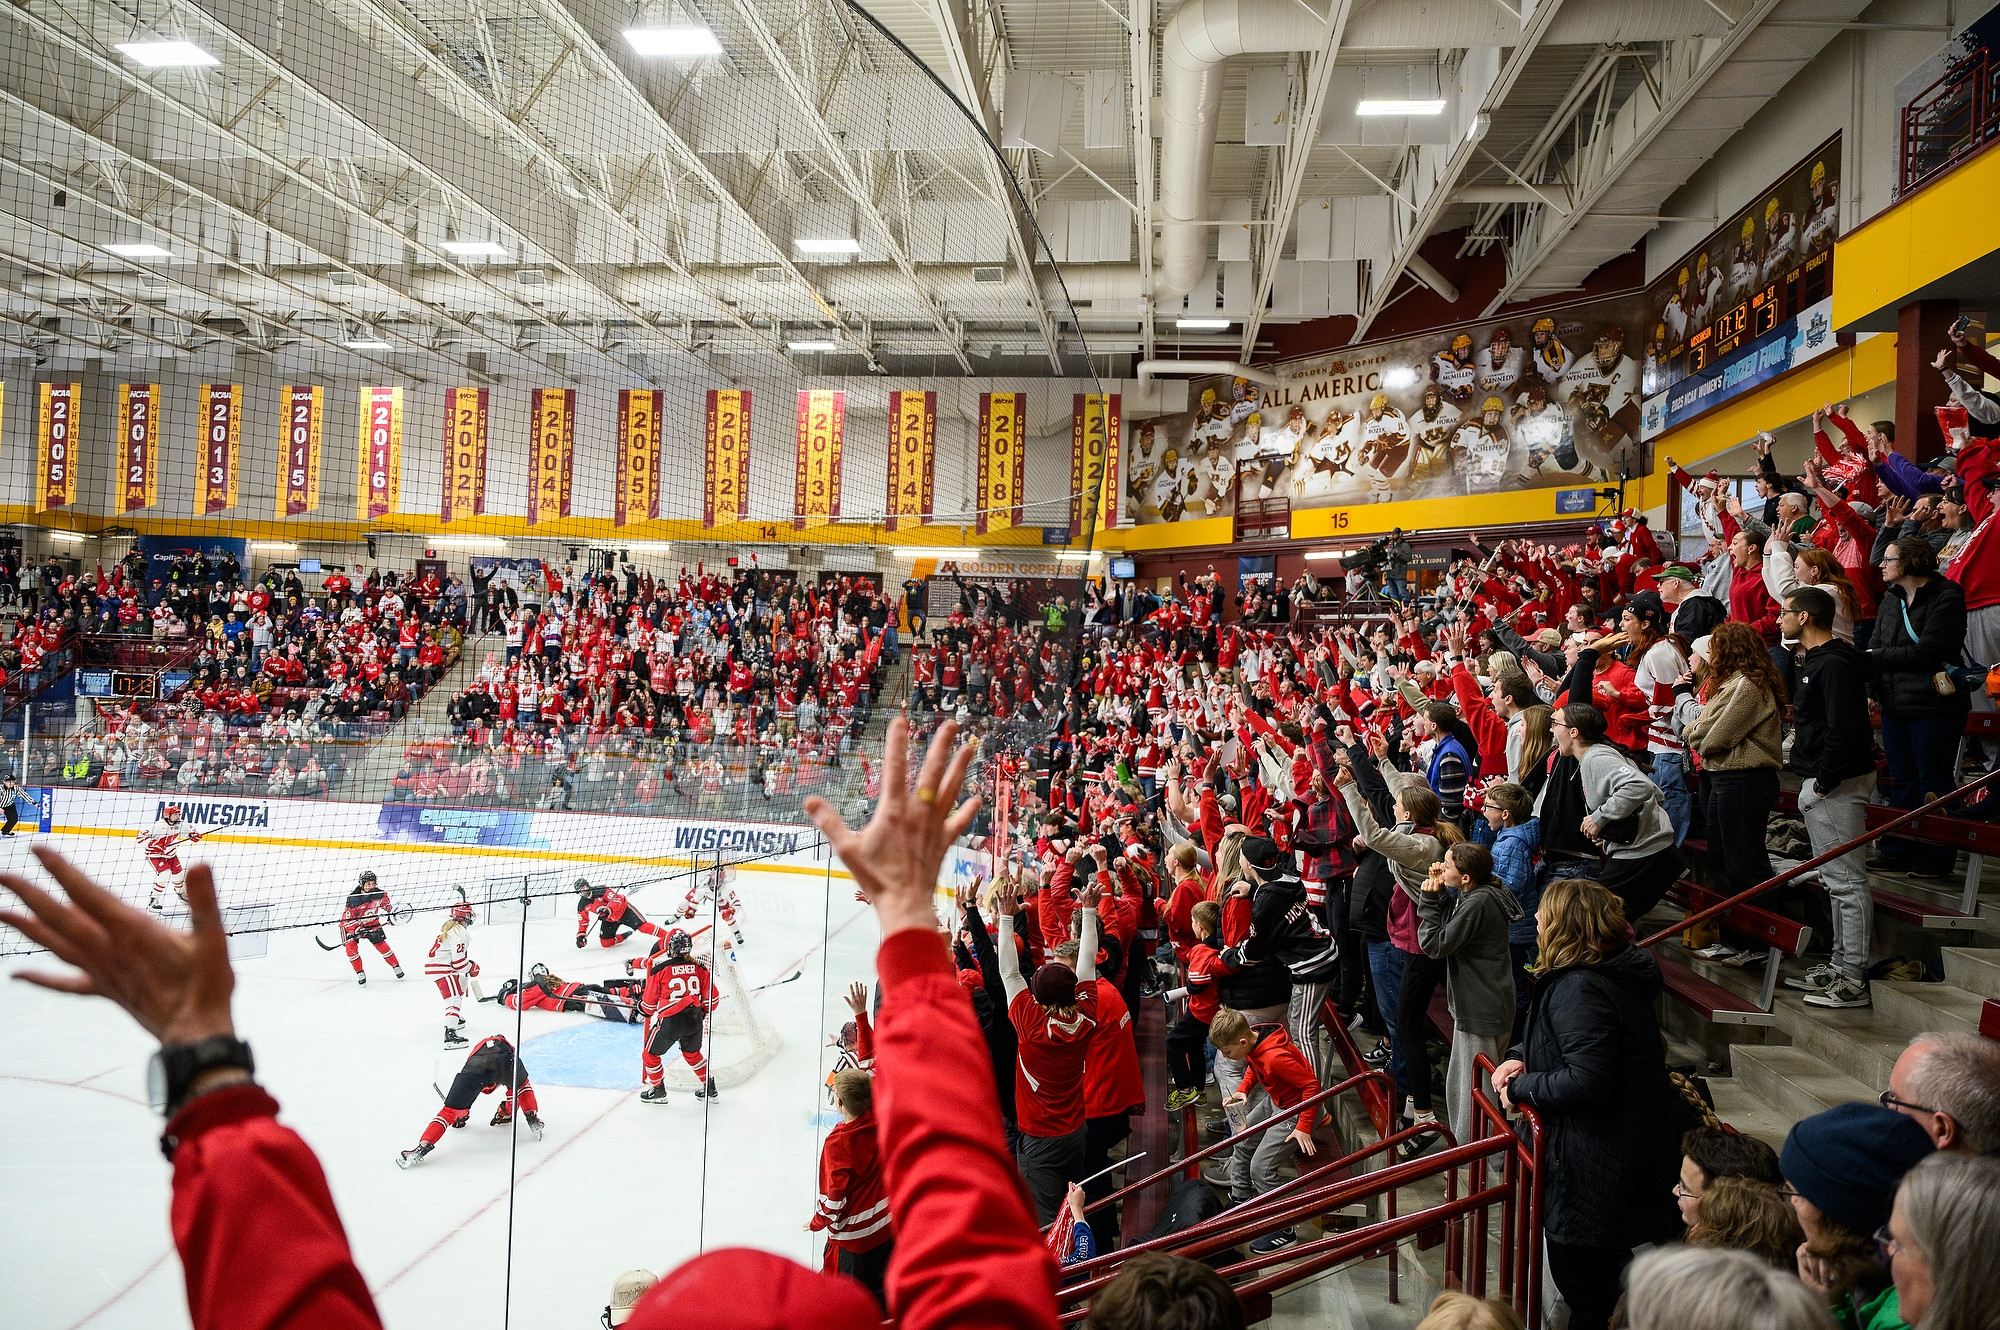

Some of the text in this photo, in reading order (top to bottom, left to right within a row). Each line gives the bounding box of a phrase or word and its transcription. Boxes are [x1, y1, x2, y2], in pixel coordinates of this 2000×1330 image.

[1766, 285, 1775, 300] ST
[1805, 250, 1828, 273] PENALTY
[1719, 305, 1746, 340] 17:12
[1733, 335, 1739, 347] 4
[1766, 303, 1774, 329] 3
[52, 389, 71, 398] NCAA
[129, 390, 150, 398] NCAA
[210, 391, 231, 399] NCAA
[292, 392, 313, 401] NCAA
[1260, 364, 1423, 409] ALL AMERICS
[1291, 367, 1327, 379] GOLDEN
[1347, 356, 1387, 369] GOPHER
[1484, 374, 1515, 384] KENNEDY
[1565, 371, 1600, 382] WENDELL
[1670, 394, 1684, 413] 2025
[1683, 388, 1697, 406] NCAA
[1698, 374, 1723, 399] WOMEN'S
[1722, 350, 1759, 391] FROZEN
[1758, 335, 1787, 373] FOUR
[1696, 347, 1704, 370] 3
[40, 402, 49, 478] NATIONAL
[51, 402, 67, 481] 2005
[68, 402, 77, 487] CHAMPIONS
[120, 403, 128, 480] NATIONAL
[130, 403, 146, 483] 2012
[148, 404, 157, 489] CHAMPIONS
[199, 404, 208, 480] NATIONAL
[210, 404, 227, 484] 2013
[230, 405, 239, 490] CHAMPIONS
[280, 405, 289, 482] NATIONAL
[291, 405, 308, 486] 2015
[310, 406, 320, 492] CHAMPIONS
[360, 407, 369, 487] NATIONAL
[372, 407, 388, 488] 2016
[391, 408, 400, 495] CHAMPIONS
[443, 408, 455, 508] TOURNAMENT
[458, 409, 473, 491] 2002
[476, 409, 486, 498] CHAMPIONS
[529, 410, 540, 509] TOURNAMENT
[542, 410, 559, 491] 2004
[562, 411, 572, 500] CHAMPIONS
[631, 411, 647, 494] 2005
[651, 411, 661, 502] CHAMPIONS
[719, 412, 735, 495] 2012
[739, 411, 749, 503] CHAMPIONS
[811, 413, 828, 497] 2013
[831, 412, 841, 504] CHAMPIONS
[902, 414, 920, 498] 2014
[924, 413, 933, 506] CHAMPIONS
[993, 415, 1009, 500] 2018
[1013, 415, 1023, 507] CHAMPIONS
[1436, 417, 1458, 425] HORAK
[617, 411, 627, 512] TOURNAMENT
[706, 411, 715, 513] TOURNAMENT
[797, 412, 807, 515] TOURNAMENT
[889, 413, 898, 517] TOURNAMENT
[1108, 416, 1118, 511] CHAMPIONS
[760, 525, 777, 540] 14
[1330, 512, 1349, 529] 15
[961, 561, 1015, 575] GOLDEN
[1018, 562, 1083, 577] GOPHERS
[1240, 572, 1273, 580] CHAMPIONS
[674, 826, 799, 856] WISCONSIN
[1950, 919, 1956, 927] 6
[671, 965, 696, 976] DISHER
